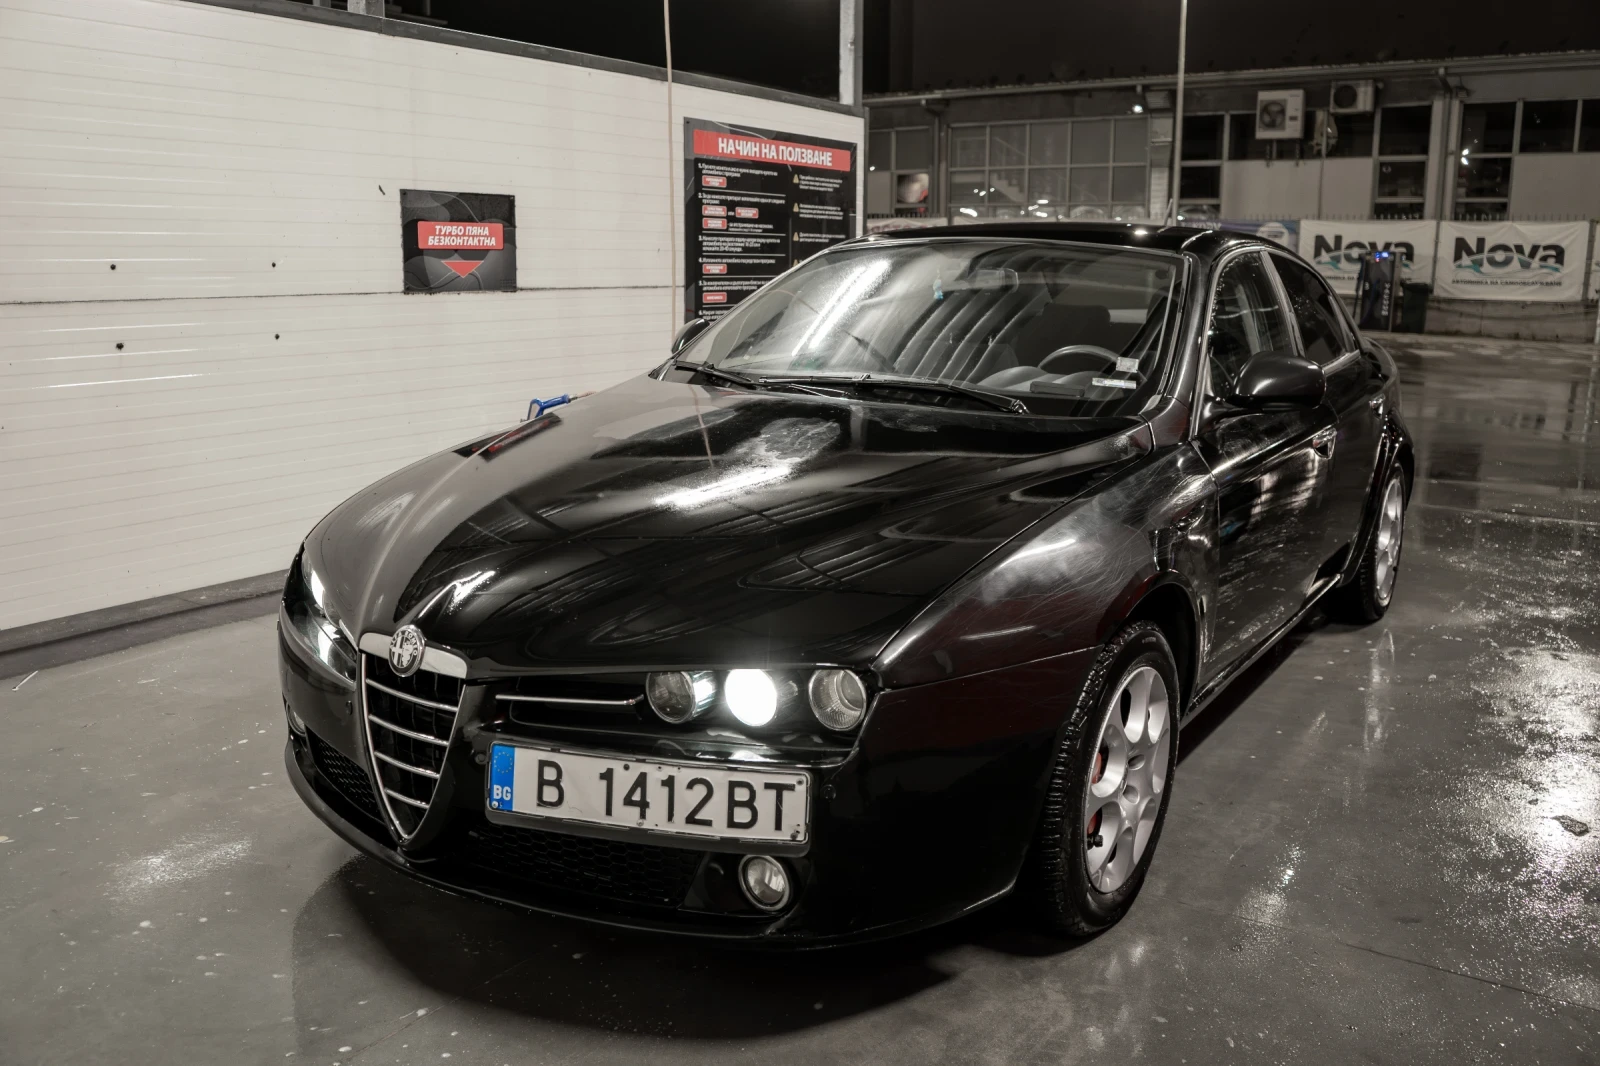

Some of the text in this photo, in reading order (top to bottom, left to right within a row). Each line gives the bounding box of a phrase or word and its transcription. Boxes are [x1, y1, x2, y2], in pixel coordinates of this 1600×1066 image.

[718, 137, 832, 166] НАЧИН НА ПОЛЗВАНЕ
[428, 236, 496, 246] БЕЗКОНТАКТНА
[435, 225, 489, 236] ТУРБО ПЯНА
[1454, 237, 1565, 271] Nova
[493, 784, 512, 800] BG
[536, 759, 565, 807] B
